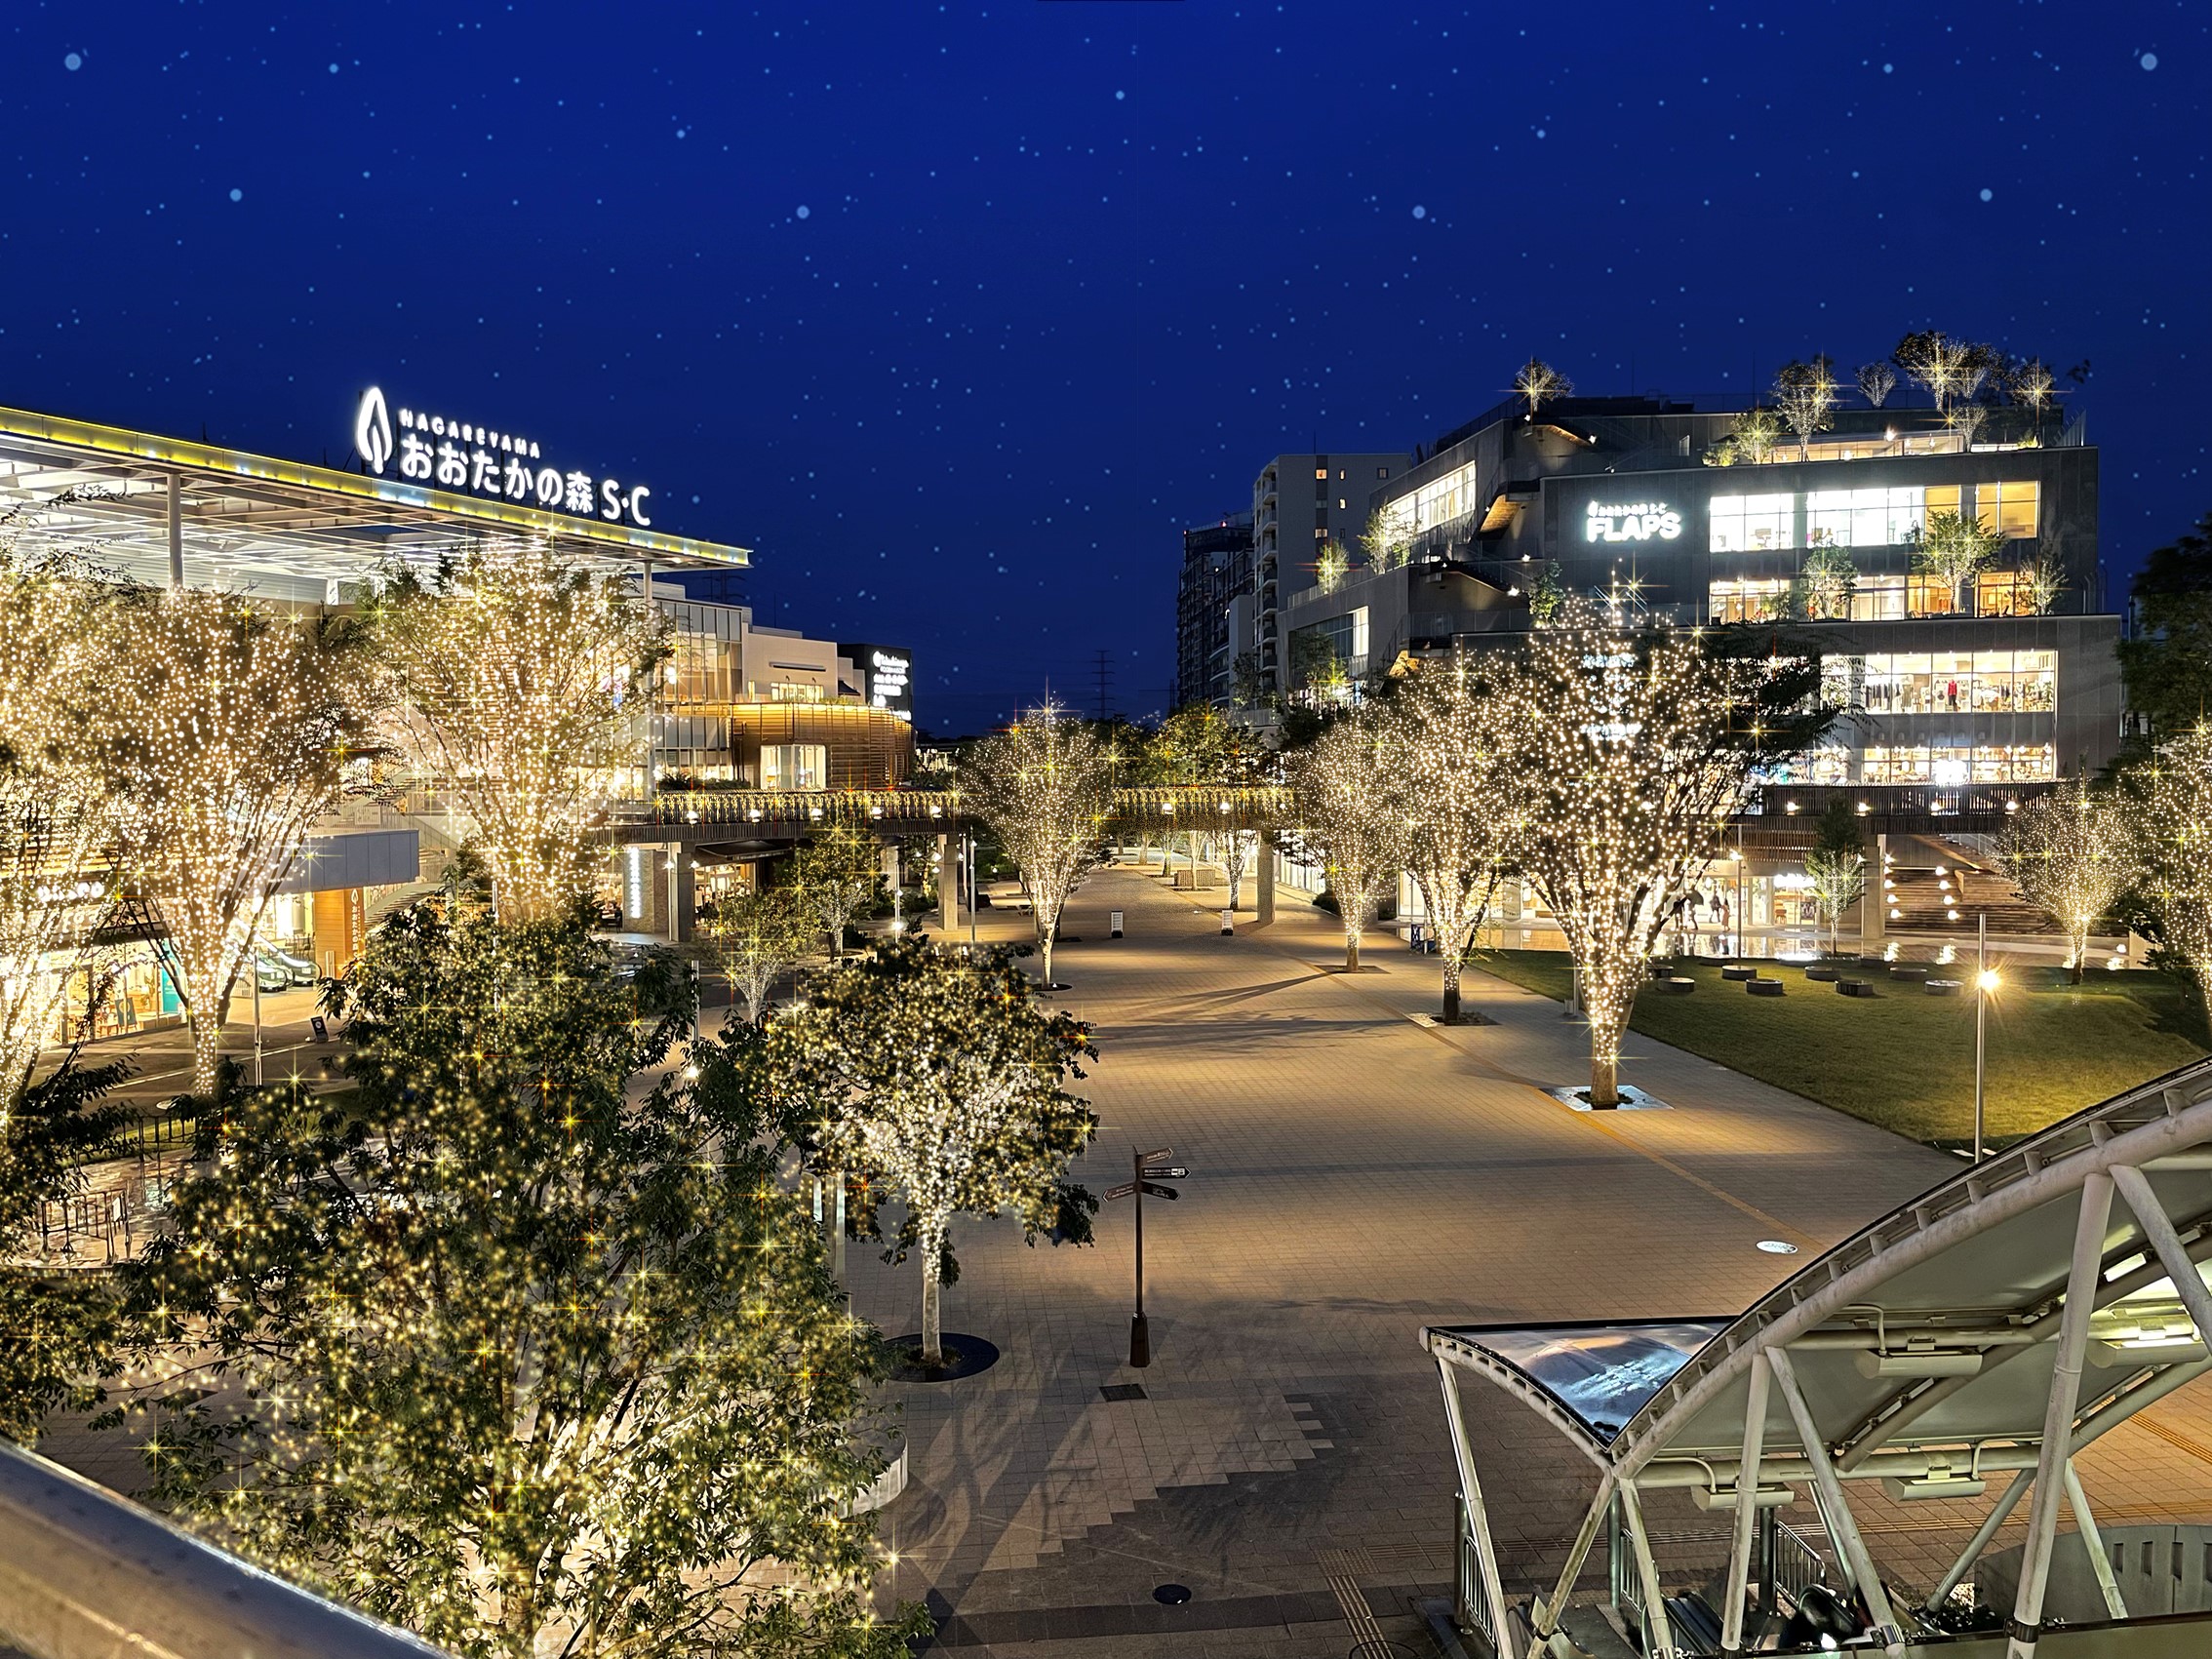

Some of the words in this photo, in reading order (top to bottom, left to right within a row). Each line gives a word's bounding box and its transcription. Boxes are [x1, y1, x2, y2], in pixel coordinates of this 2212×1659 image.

[400, 433, 594, 514] おおたかの森
[1586, 511, 1682, 543] FLAPS
